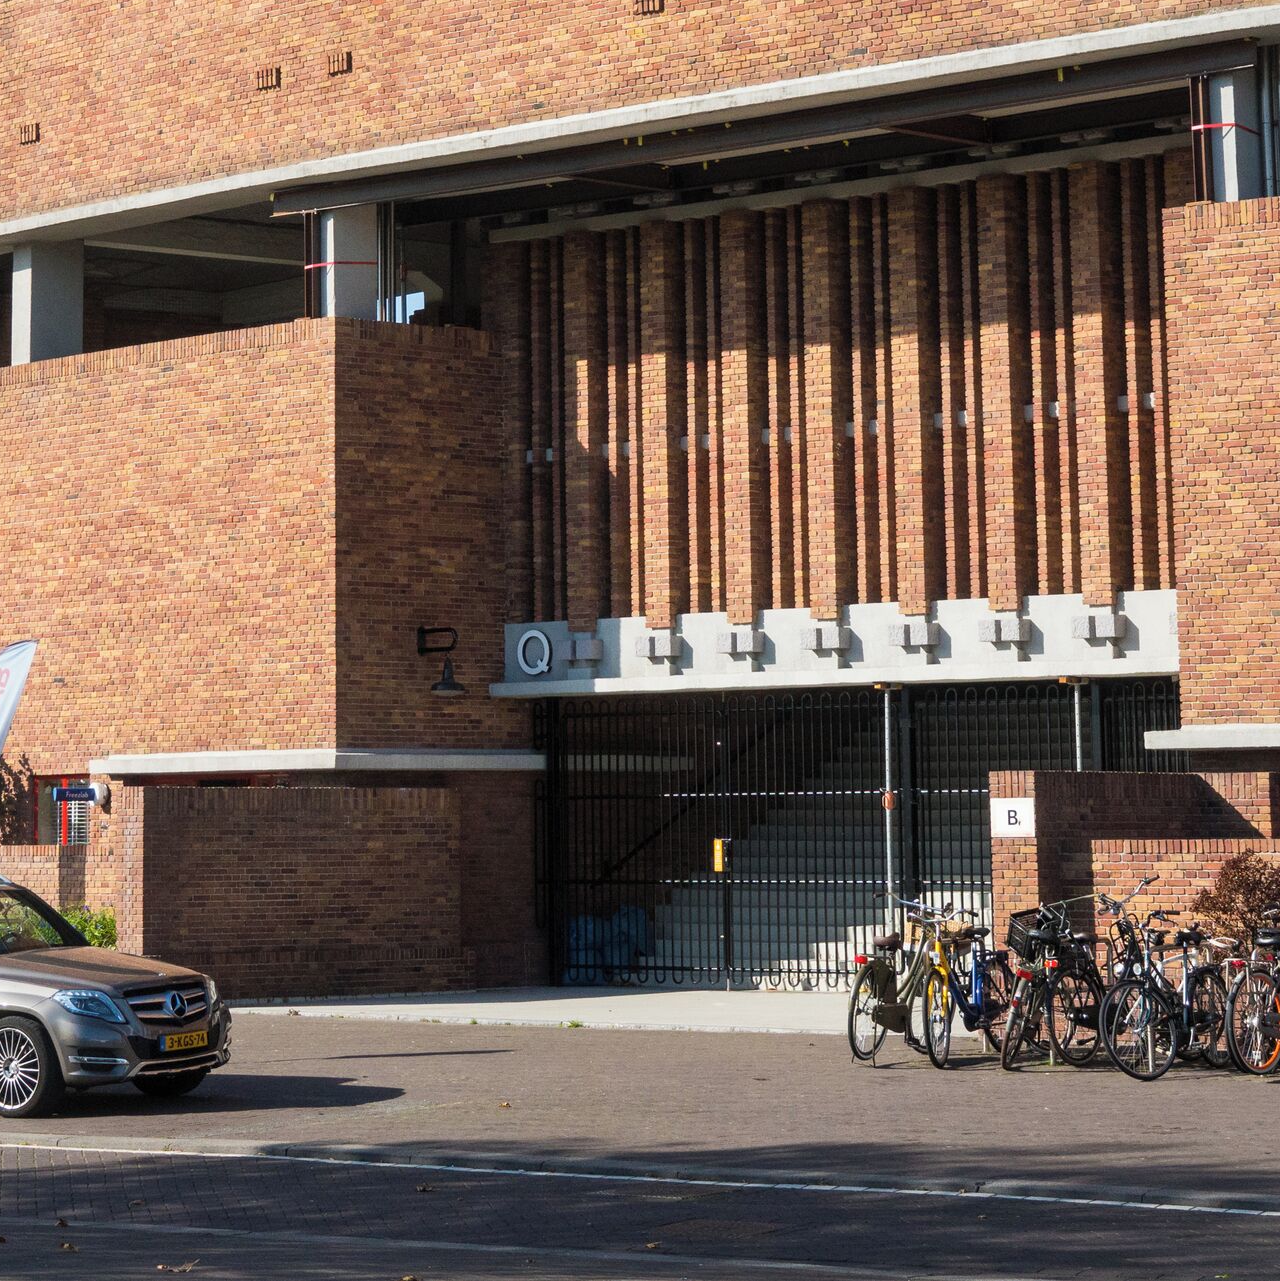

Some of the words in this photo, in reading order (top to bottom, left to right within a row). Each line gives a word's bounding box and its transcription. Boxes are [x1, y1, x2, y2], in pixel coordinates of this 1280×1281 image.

[517, 630, 550, 675] Q
[65, 790, 89, 799] Freezlab
[169, 1033, 205, 1049] 3-KGS-74
